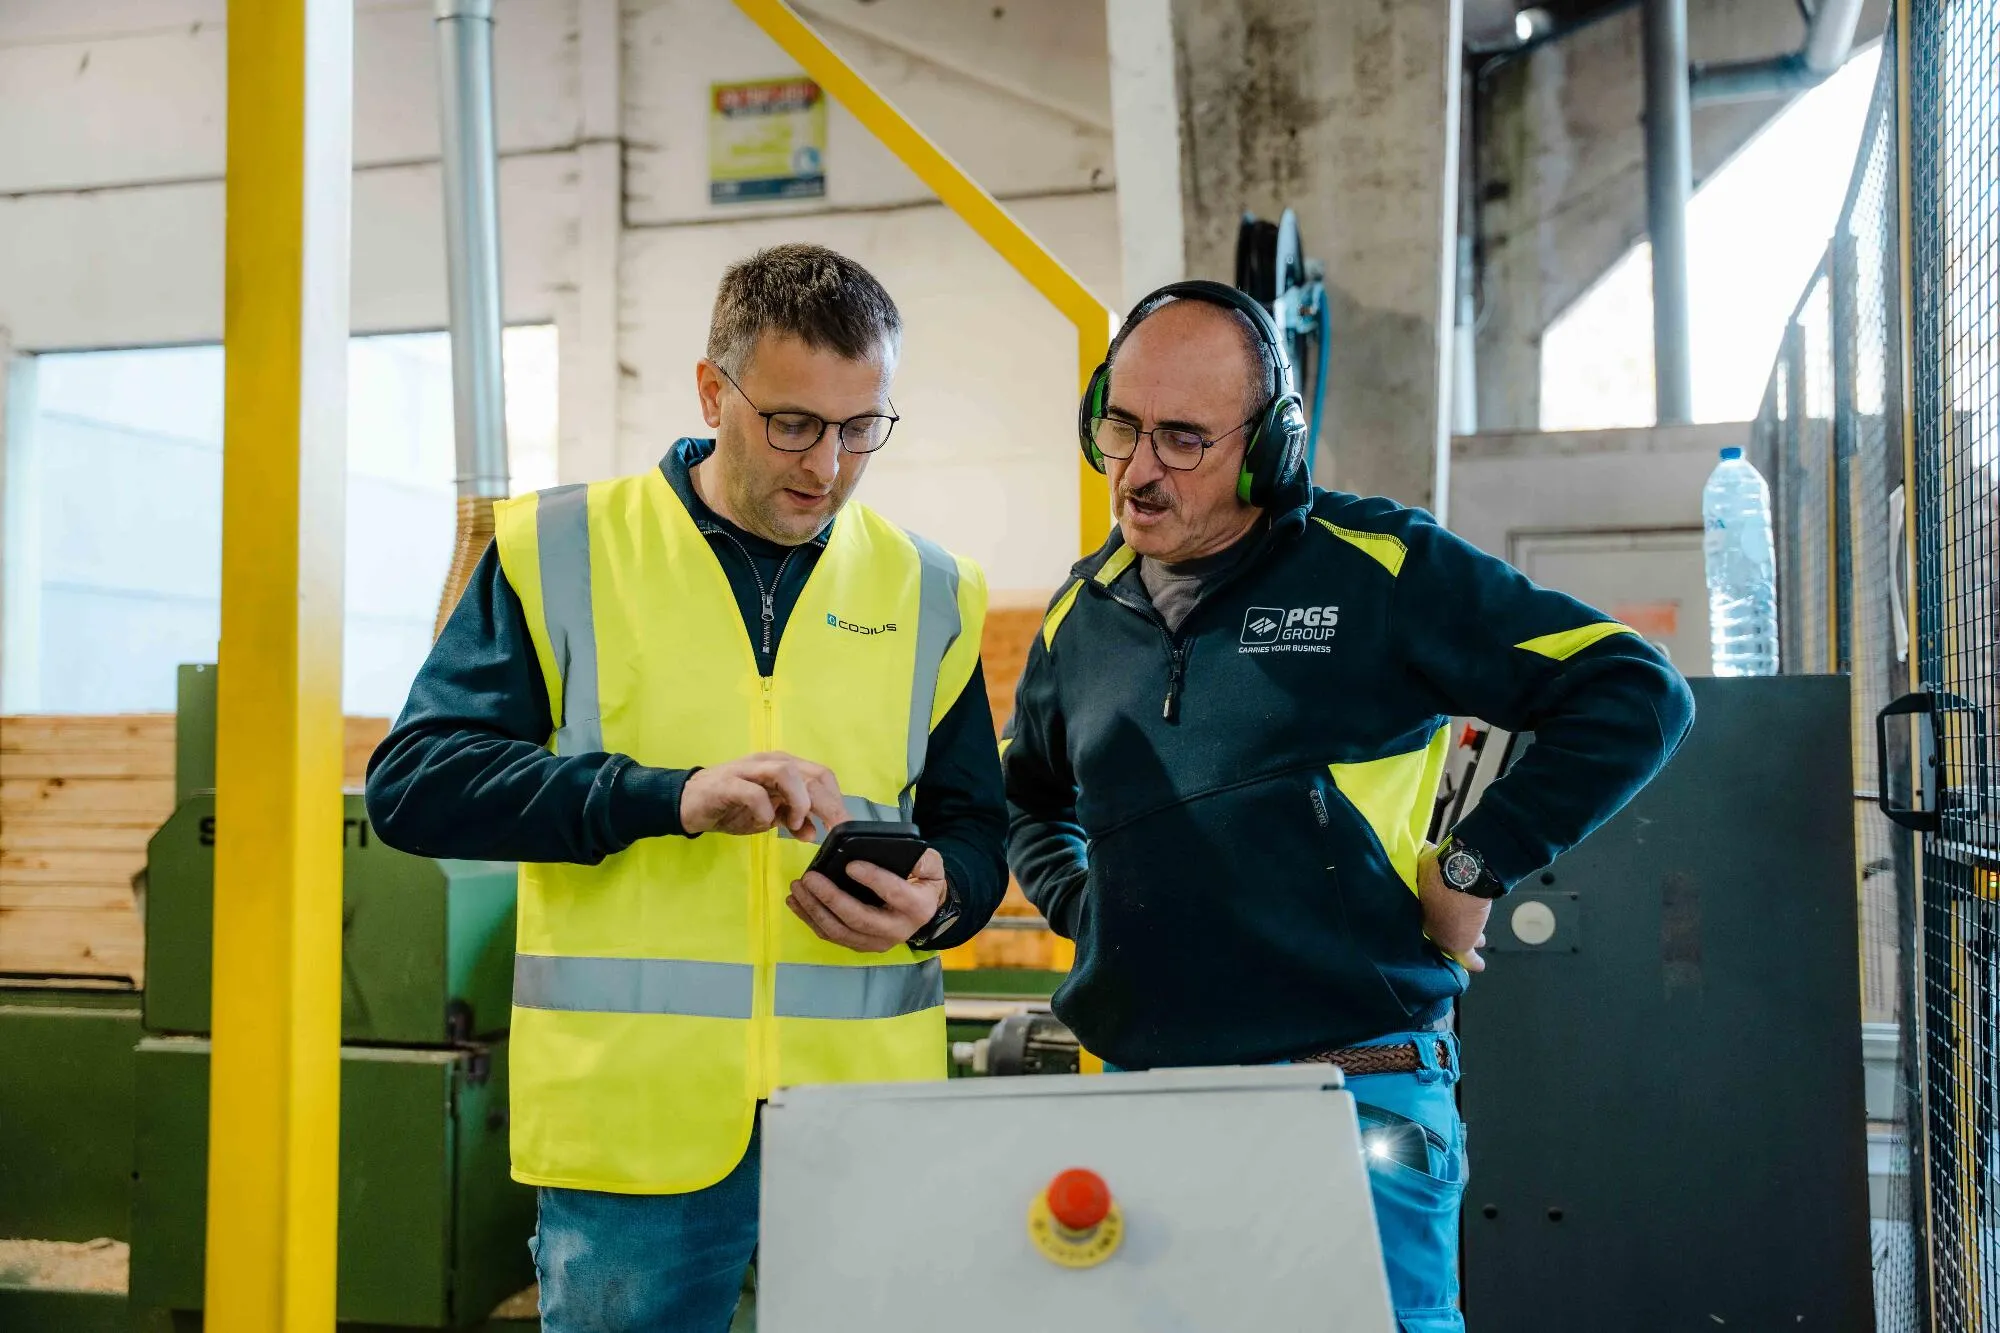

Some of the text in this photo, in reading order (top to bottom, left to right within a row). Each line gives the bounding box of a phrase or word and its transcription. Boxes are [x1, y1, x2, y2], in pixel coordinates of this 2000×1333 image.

[1285, 605, 1340, 628] PGS
[1282, 627, 1336, 641] GROUP
[1238, 644, 1332, 654] CARRIES YOUR BUSINESS
